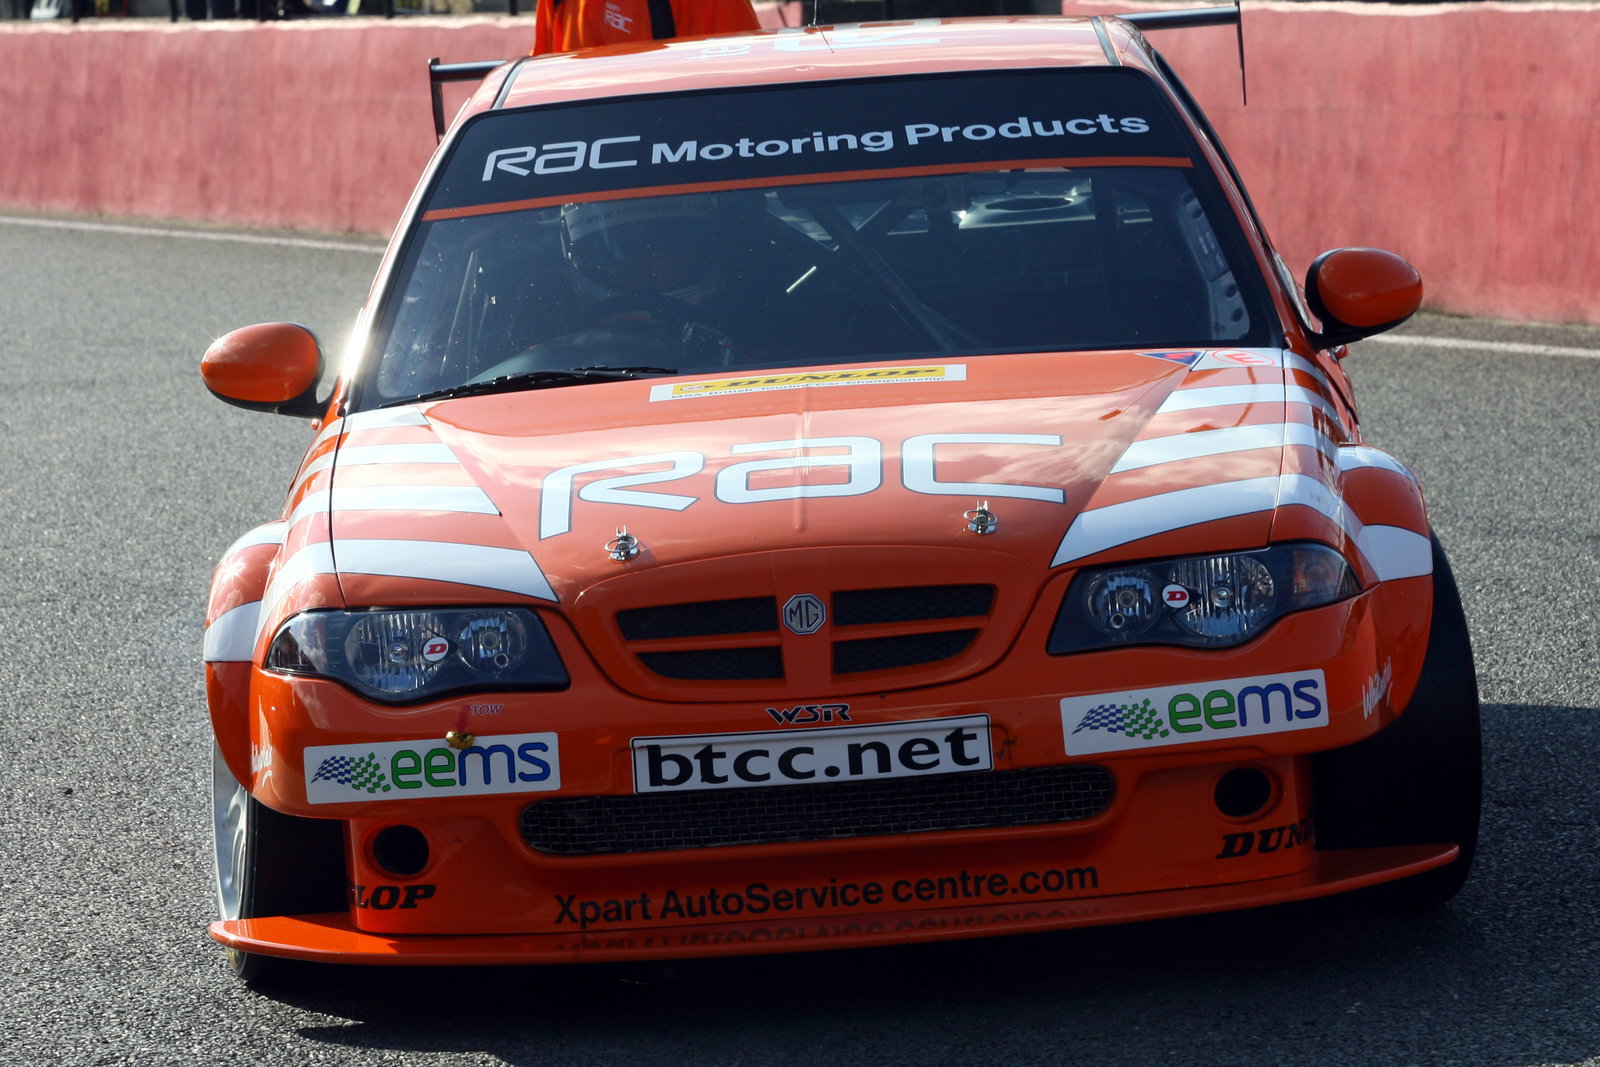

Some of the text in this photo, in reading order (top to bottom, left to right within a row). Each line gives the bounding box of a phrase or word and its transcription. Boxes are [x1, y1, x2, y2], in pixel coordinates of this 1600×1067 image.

[651, 130, 894, 164] Motoring
[905, 113, 1150, 146] Products
[720, 369, 938, 388] DUNLOP
[789, 599, 820, 629] MG
[470, 703, 505, 717] TOW
[764, 702, 853, 726] WSR
[1167, 678, 1322, 734] eems
[390, 741, 551, 790] eems
[646, 726, 982, 788] btcc.net
[553, 865, 1099, 930] Xpart AutoService centre.com
